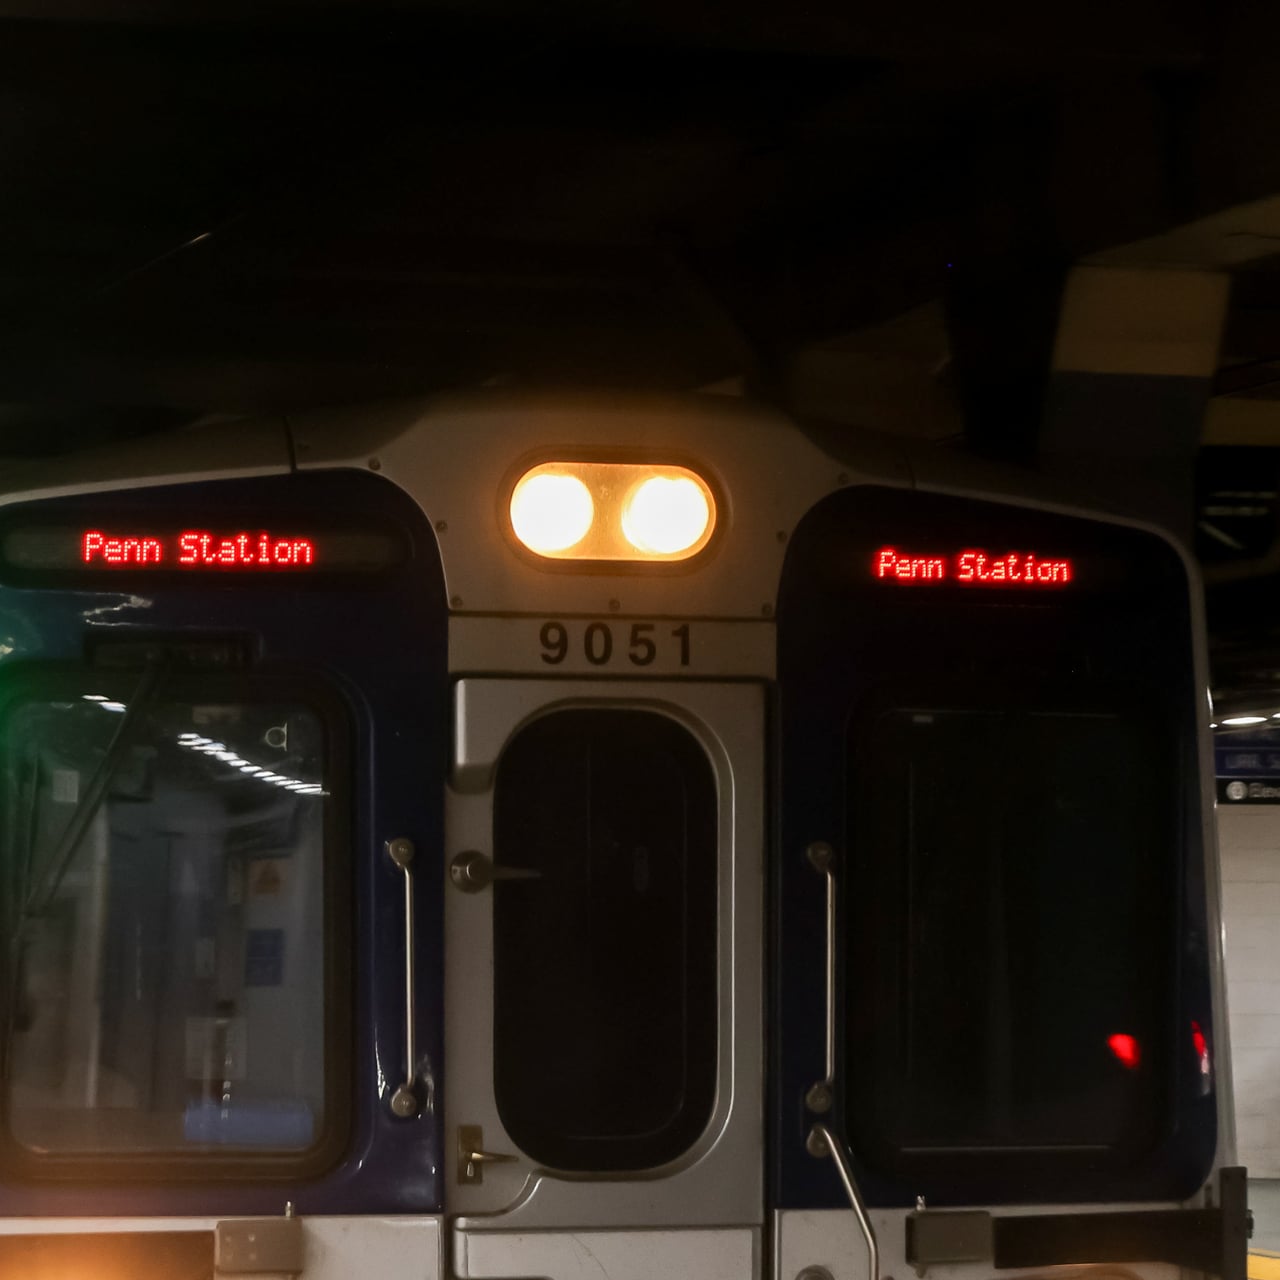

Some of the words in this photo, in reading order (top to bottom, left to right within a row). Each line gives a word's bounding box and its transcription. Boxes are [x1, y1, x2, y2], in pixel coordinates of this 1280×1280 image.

[84, 531, 162, 563] Penn
[179, 532, 314, 564] Station
[877, 550, 945, 579] Penn
[957, 552, 1070, 583] Station
[538, 621, 691, 667] 9051
